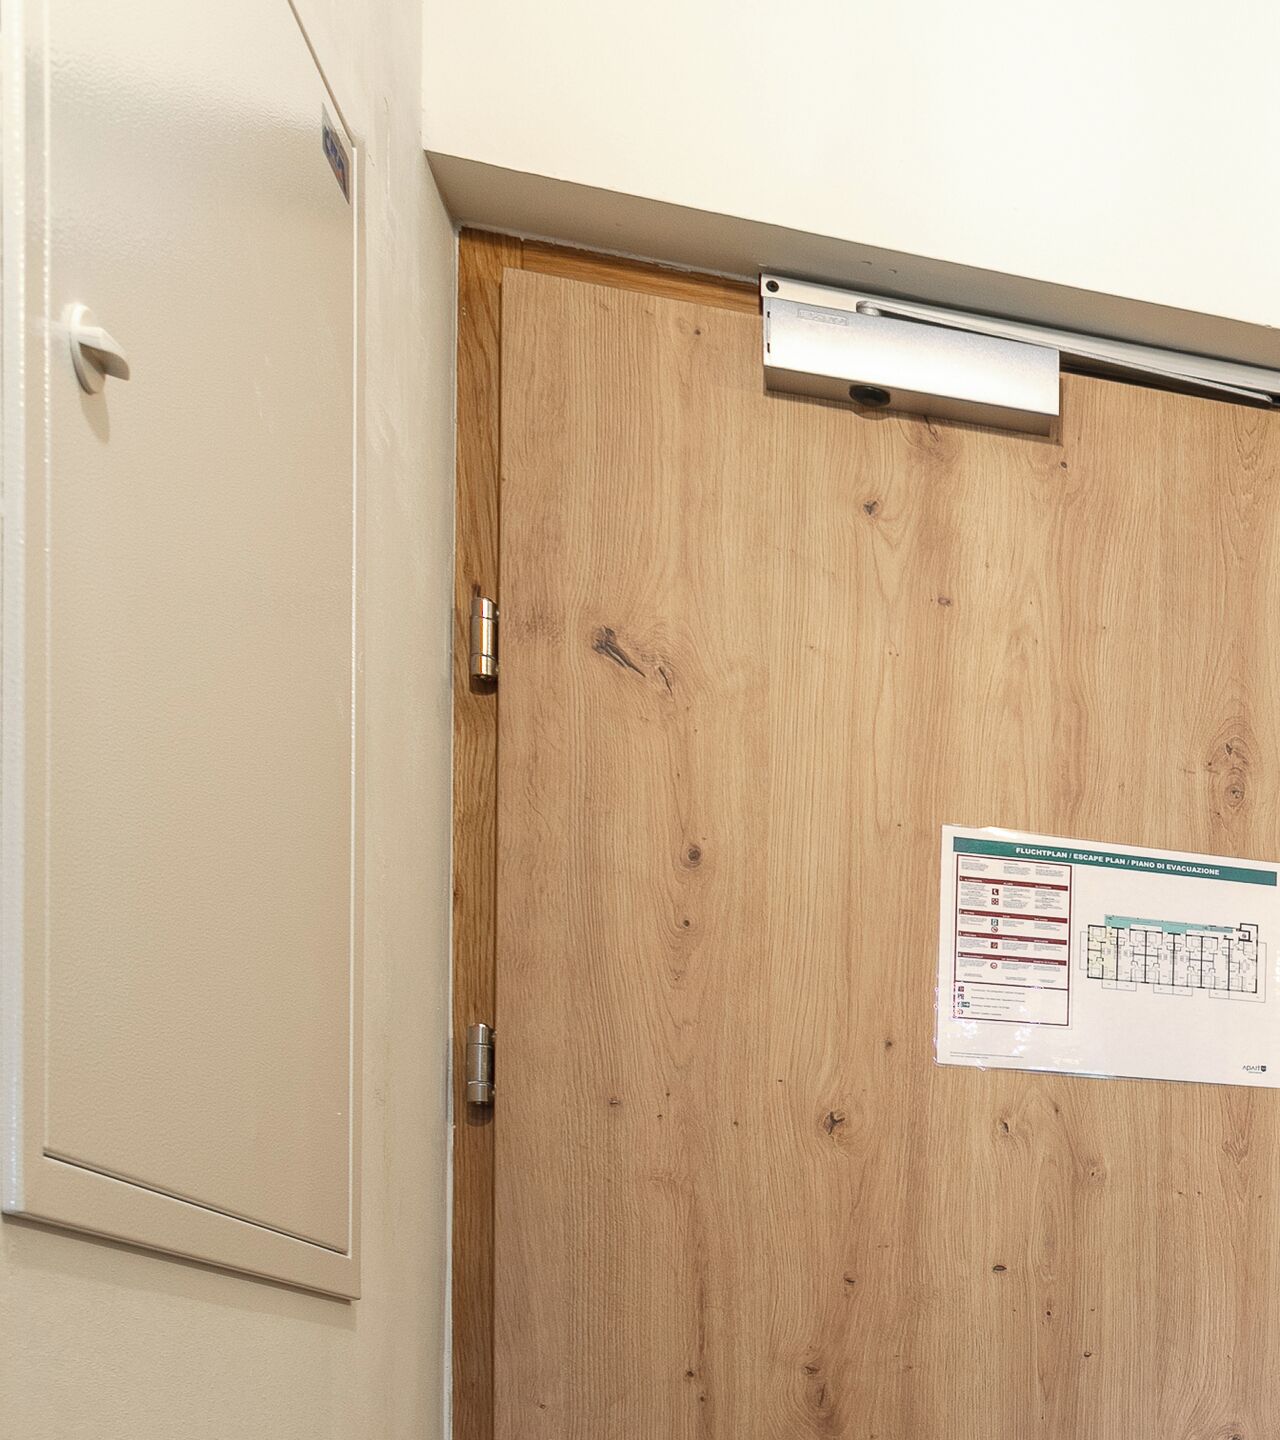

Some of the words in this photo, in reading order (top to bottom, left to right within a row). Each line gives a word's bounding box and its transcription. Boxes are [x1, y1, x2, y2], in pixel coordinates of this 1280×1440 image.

[1015, 847, 1067, 858] FLUCHTPLAN
[1073, 853, 1104, 862] ESCAPE
[1105, 856, 1125, 865] PLAN
[1131, 860, 1155, 868] PIANO
[1166, 864, 1220, 875] EVACUAZIONE
